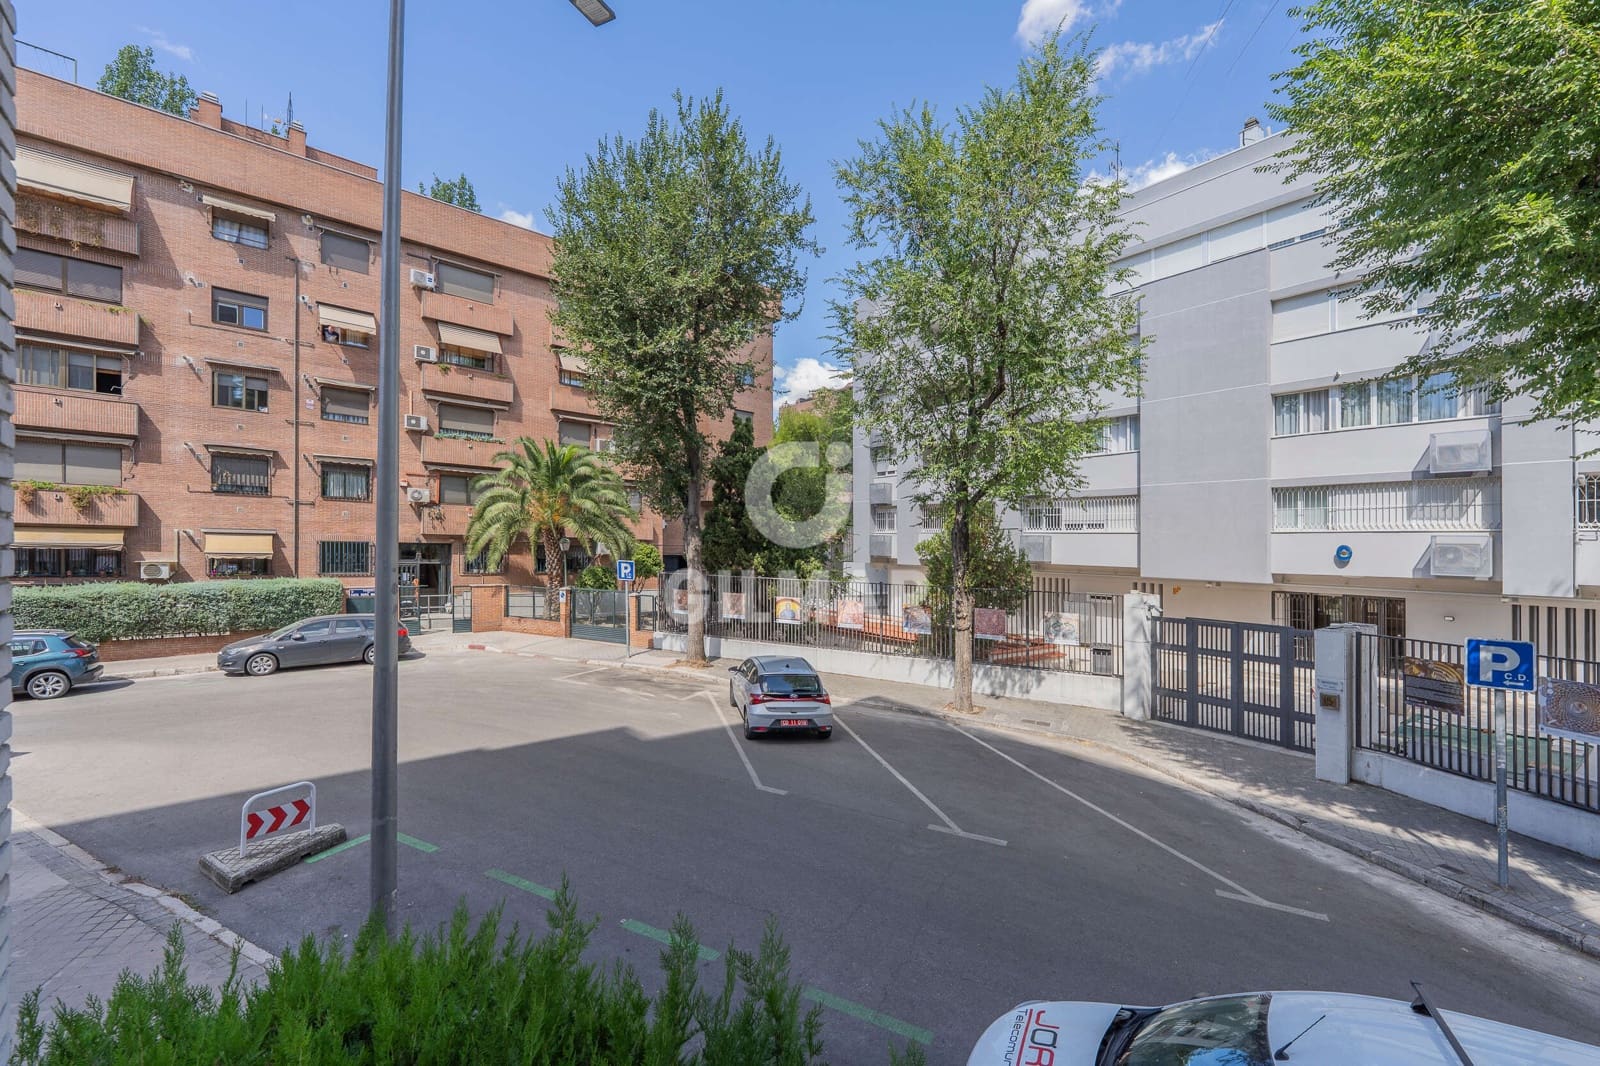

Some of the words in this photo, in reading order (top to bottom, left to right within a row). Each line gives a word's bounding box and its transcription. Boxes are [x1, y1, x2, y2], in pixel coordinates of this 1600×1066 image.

[620, 563, 632, 578] P
[1480, 645, 1520, 682] P
[1504, 672, 1530, 682] C.D.
